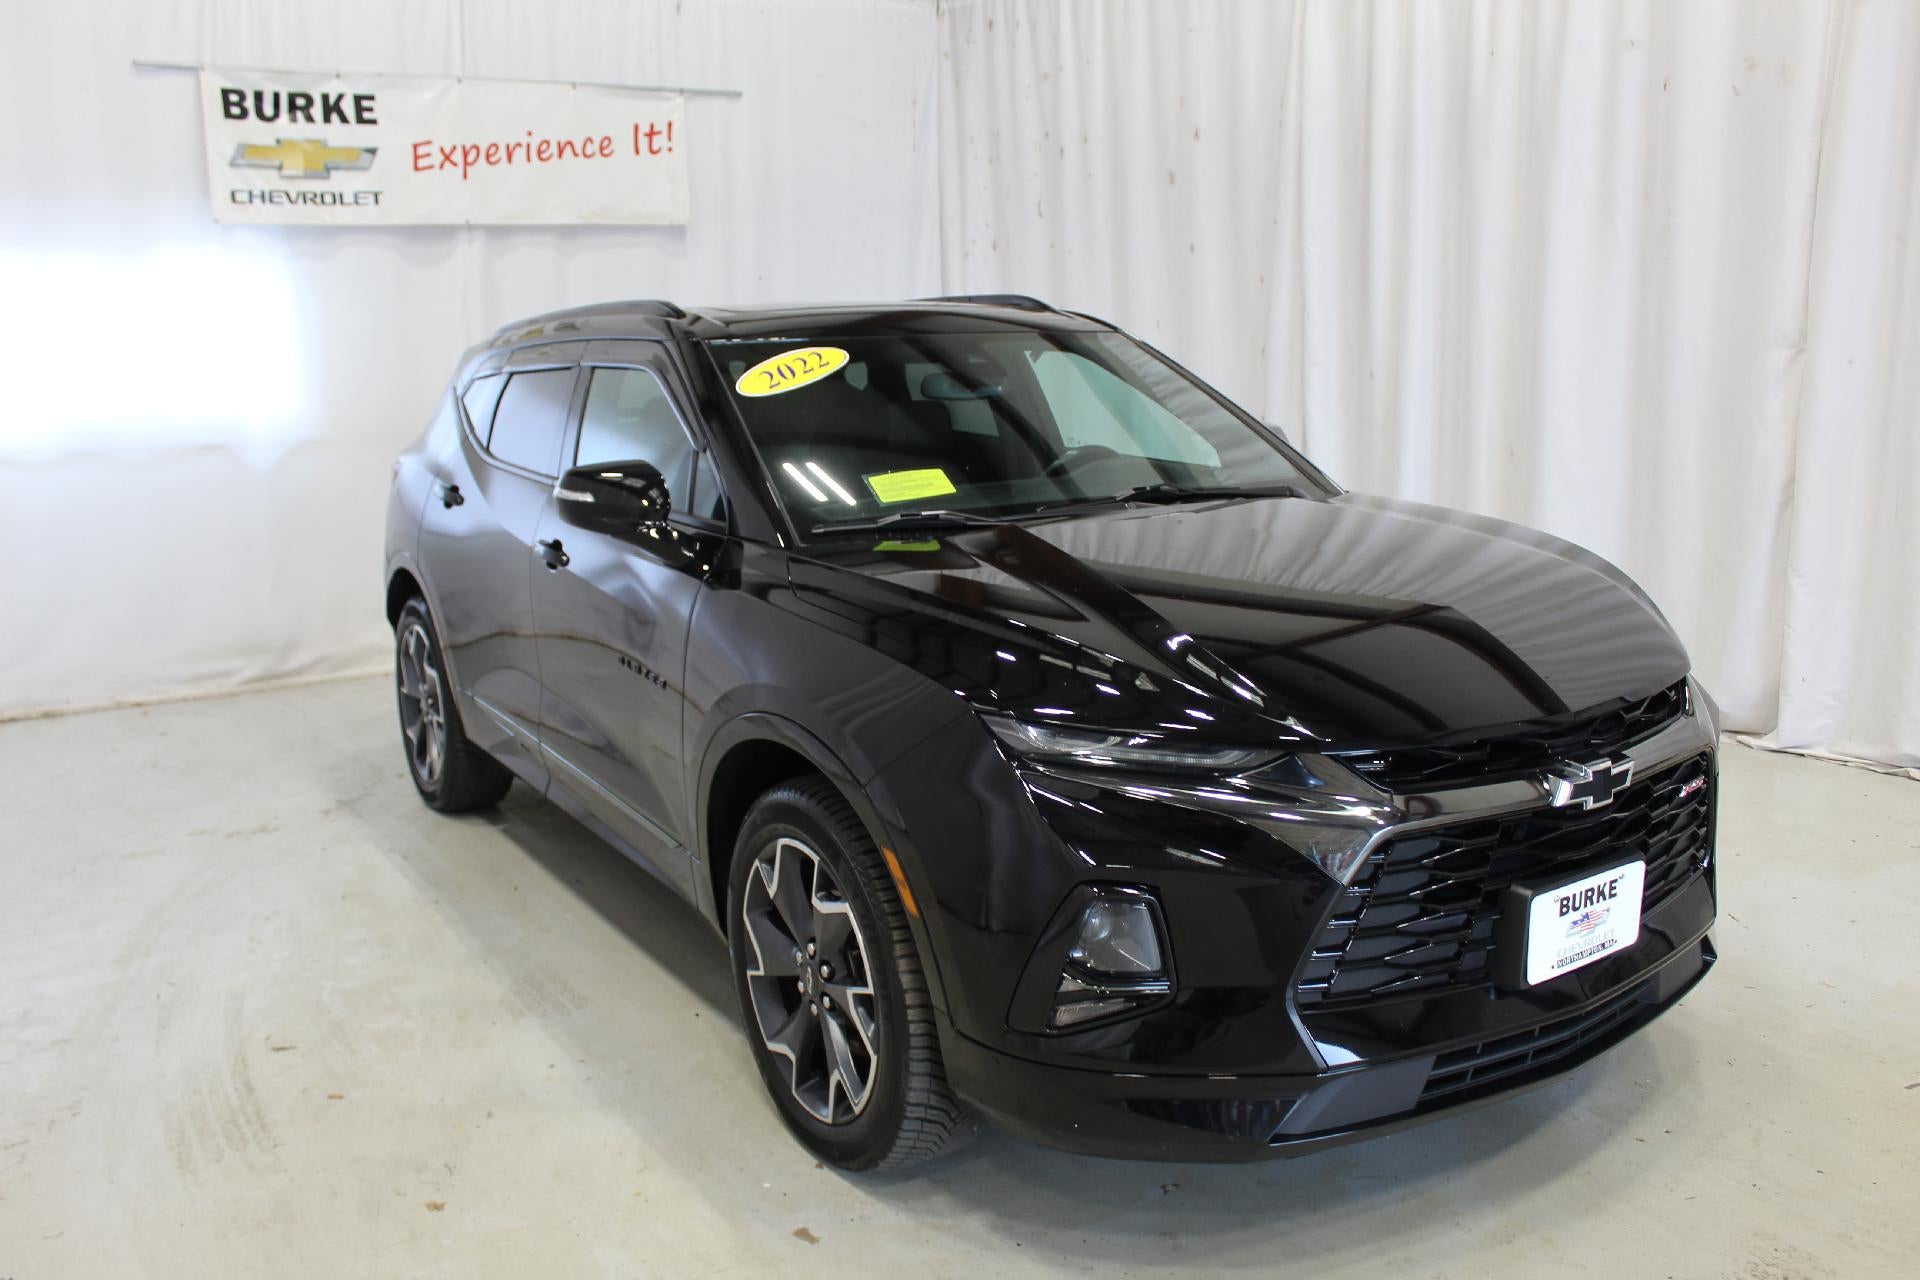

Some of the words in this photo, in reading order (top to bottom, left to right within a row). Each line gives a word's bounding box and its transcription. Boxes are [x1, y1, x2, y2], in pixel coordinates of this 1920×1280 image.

[220, 86, 378, 125] BURKE
[411, 131, 614, 179] Experience
[633, 121, 675, 156] It!
[231, 189, 384, 206] CHEVROLET
[759, 352, 830, 389] 2022
[1559, 879, 1619, 917] BURKE
[1556, 929, 1616, 956] CHEVROLET
